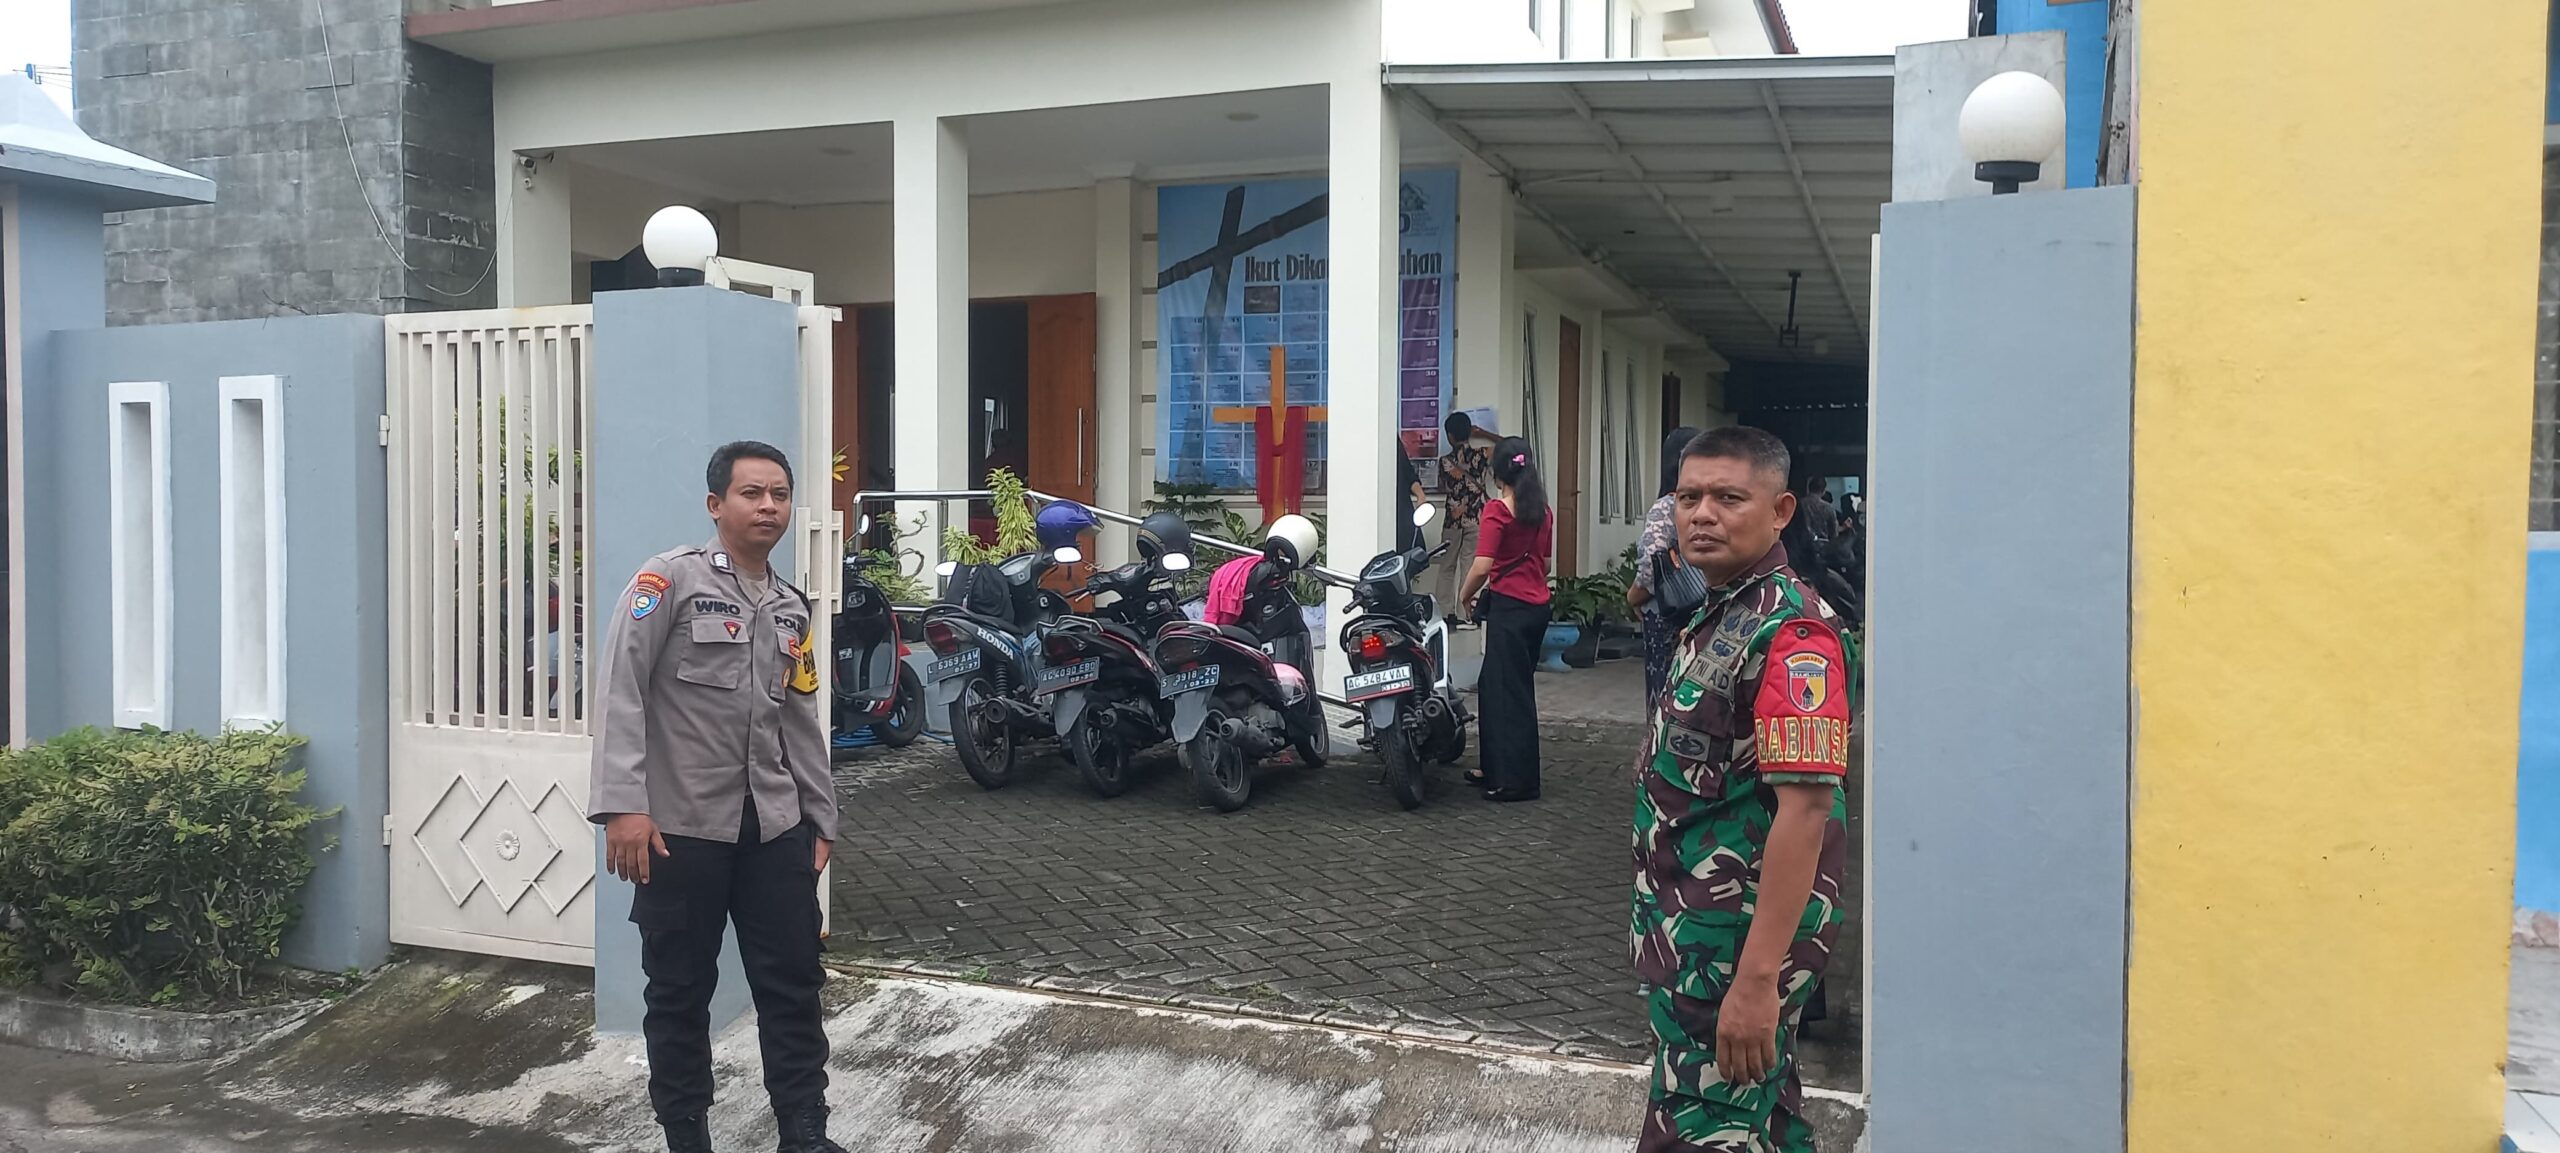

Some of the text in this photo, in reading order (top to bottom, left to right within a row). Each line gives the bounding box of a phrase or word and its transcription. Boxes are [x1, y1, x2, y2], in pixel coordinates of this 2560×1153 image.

[1245, 256, 1280, 282] Ikut
[1286, 253, 1329, 281] Dika
[695, 600, 740, 615] WIRO
[774, 615, 802, 635] POLI
[977, 627, 1014, 660] HONDA
[928, 664, 933, 674] L
[961, 650, 979, 663] AAW
[1162, 678, 1168, 687] S
[1205, 666, 1217, 676] ZC
[1348, 667, 1408, 689] AG 5484 VAL
[1692, 659, 1729, 690] TNI AD
